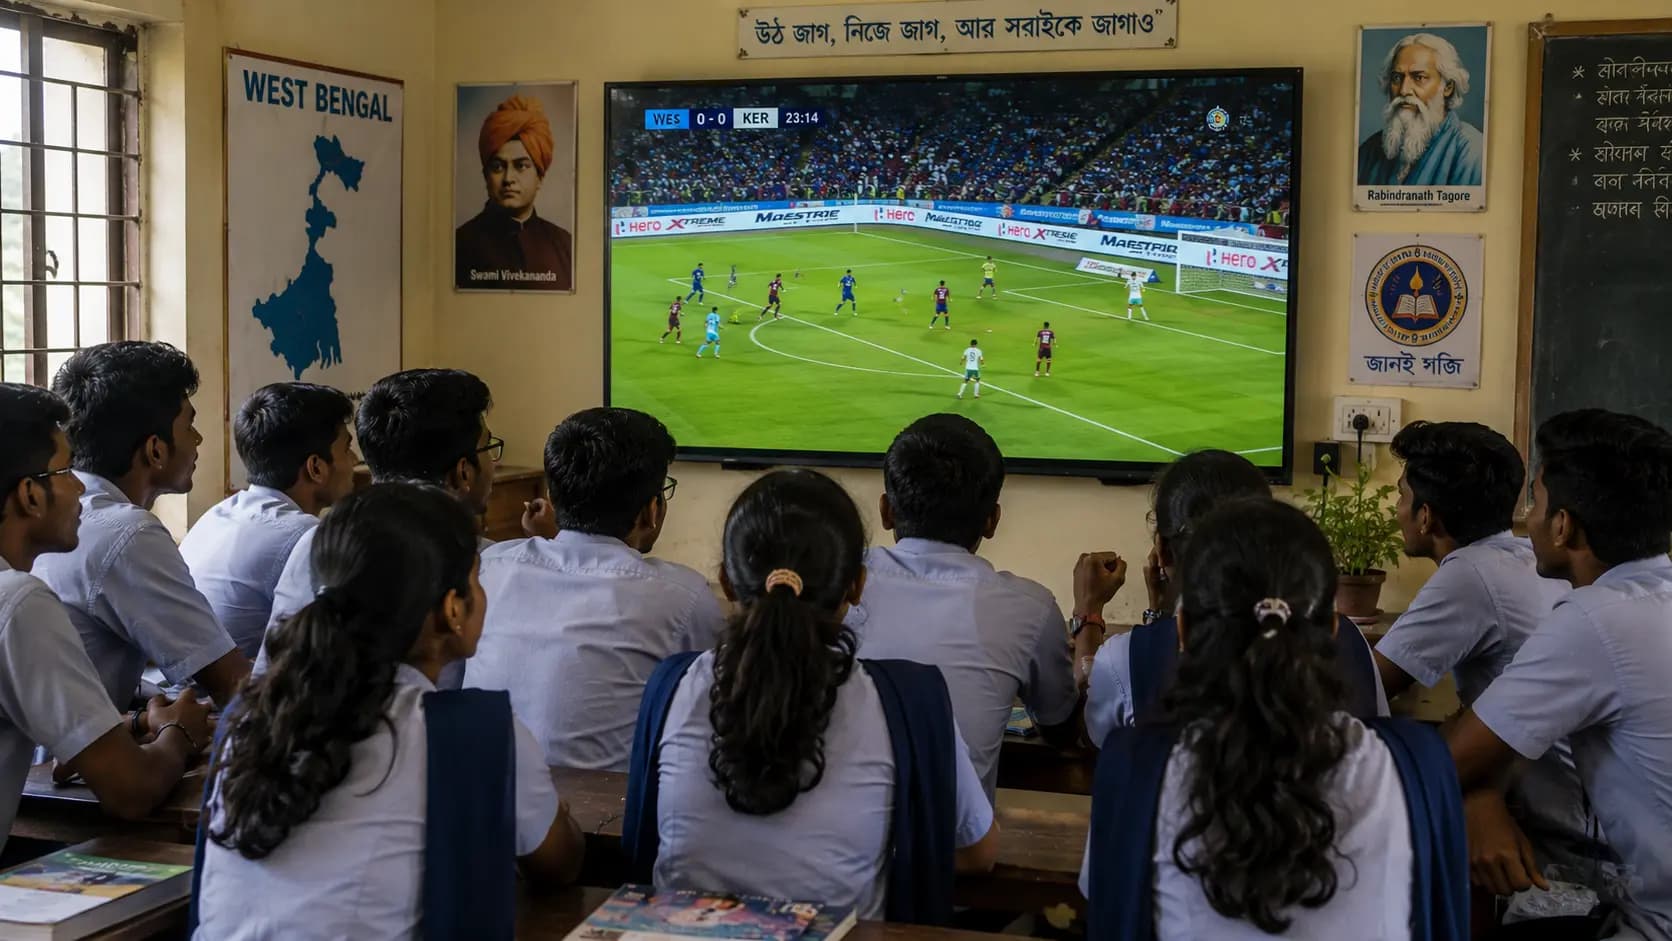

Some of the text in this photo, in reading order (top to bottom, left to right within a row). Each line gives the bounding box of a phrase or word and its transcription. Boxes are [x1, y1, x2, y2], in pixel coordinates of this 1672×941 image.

[754, 16, 785, 45] উঠ
[792, 22, 836, 47] জাগ,
[844, 15, 892, 43] নিজে
[899, 18, 946, 44] জাগ,
[955, 16, 996, 39] আর
[243, 69, 393, 123] WEST BENGAL
[652, 113, 681, 126] WES
[742, 112, 769, 125] KER
[785, 111, 819, 125] 23:14
[1367, 189, 1471, 203] Rabindranath Tagore
[629, 220, 662, 233] Hero
[1221, 251, 1257, 268] Hero
[470, 268, 557, 282] Swami Vivekananda
